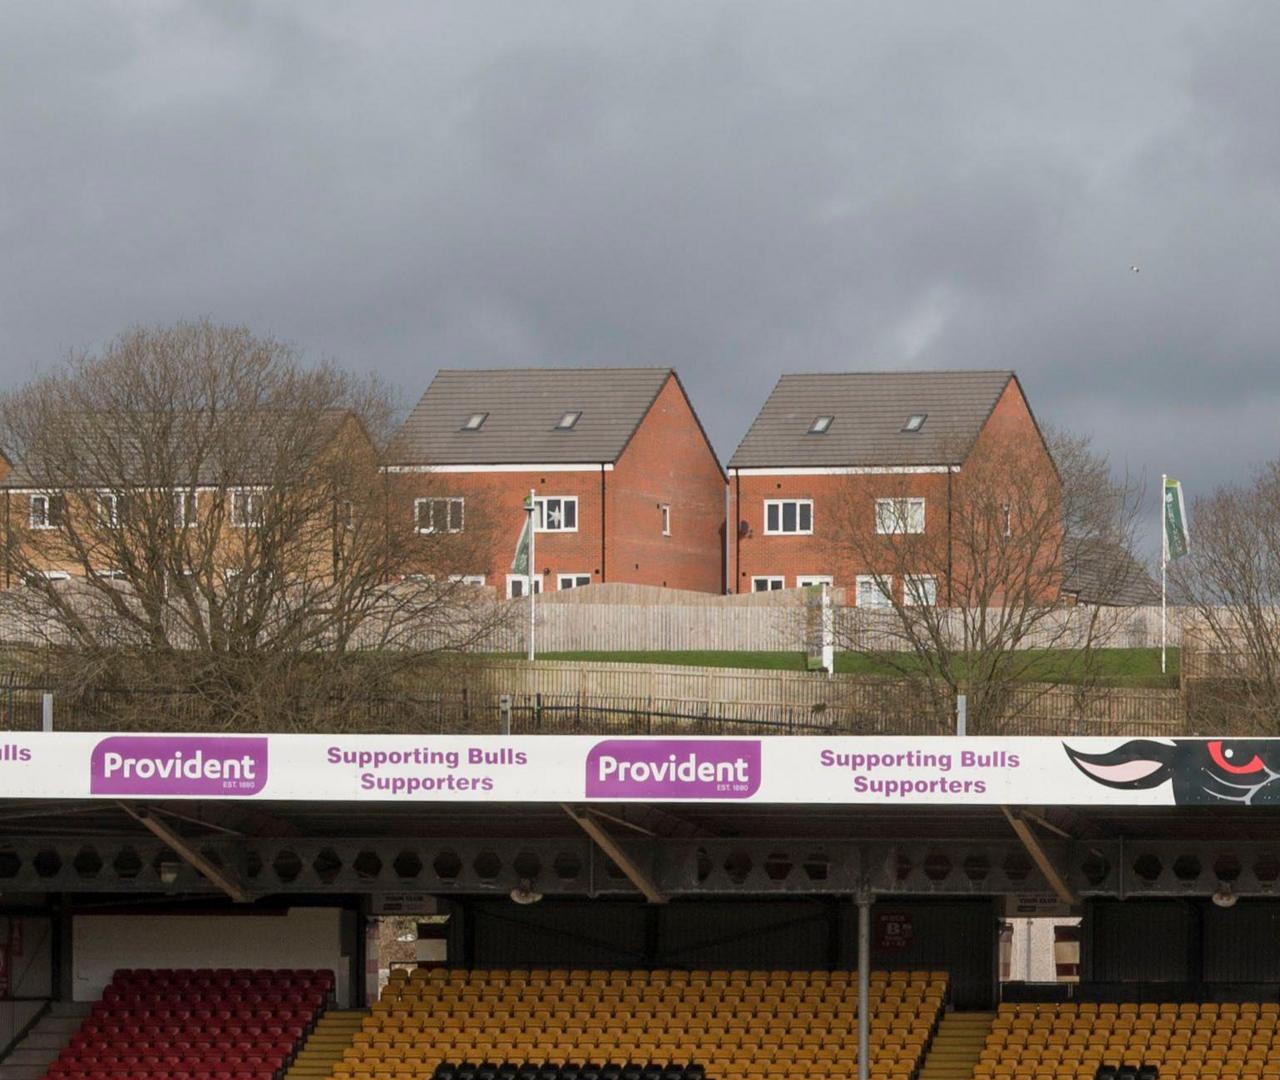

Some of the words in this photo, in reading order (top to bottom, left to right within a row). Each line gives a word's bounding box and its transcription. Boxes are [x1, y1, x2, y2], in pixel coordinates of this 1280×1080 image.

[0, 744, 31, 761] lls
[327, 746, 462, 768] Supporting
[468, 746, 528, 765] Bulls
[820, 749, 953, 771] Supporting
[960, 749, 1020, 768] Bulls
[104, 750, 256, 779] Provident
[599, 752, 749, 783] Provident
[361, 772, 494, 794] Supporters
[853, 775, 986, 797] Supporters
[887, 922, 900, 935] B
